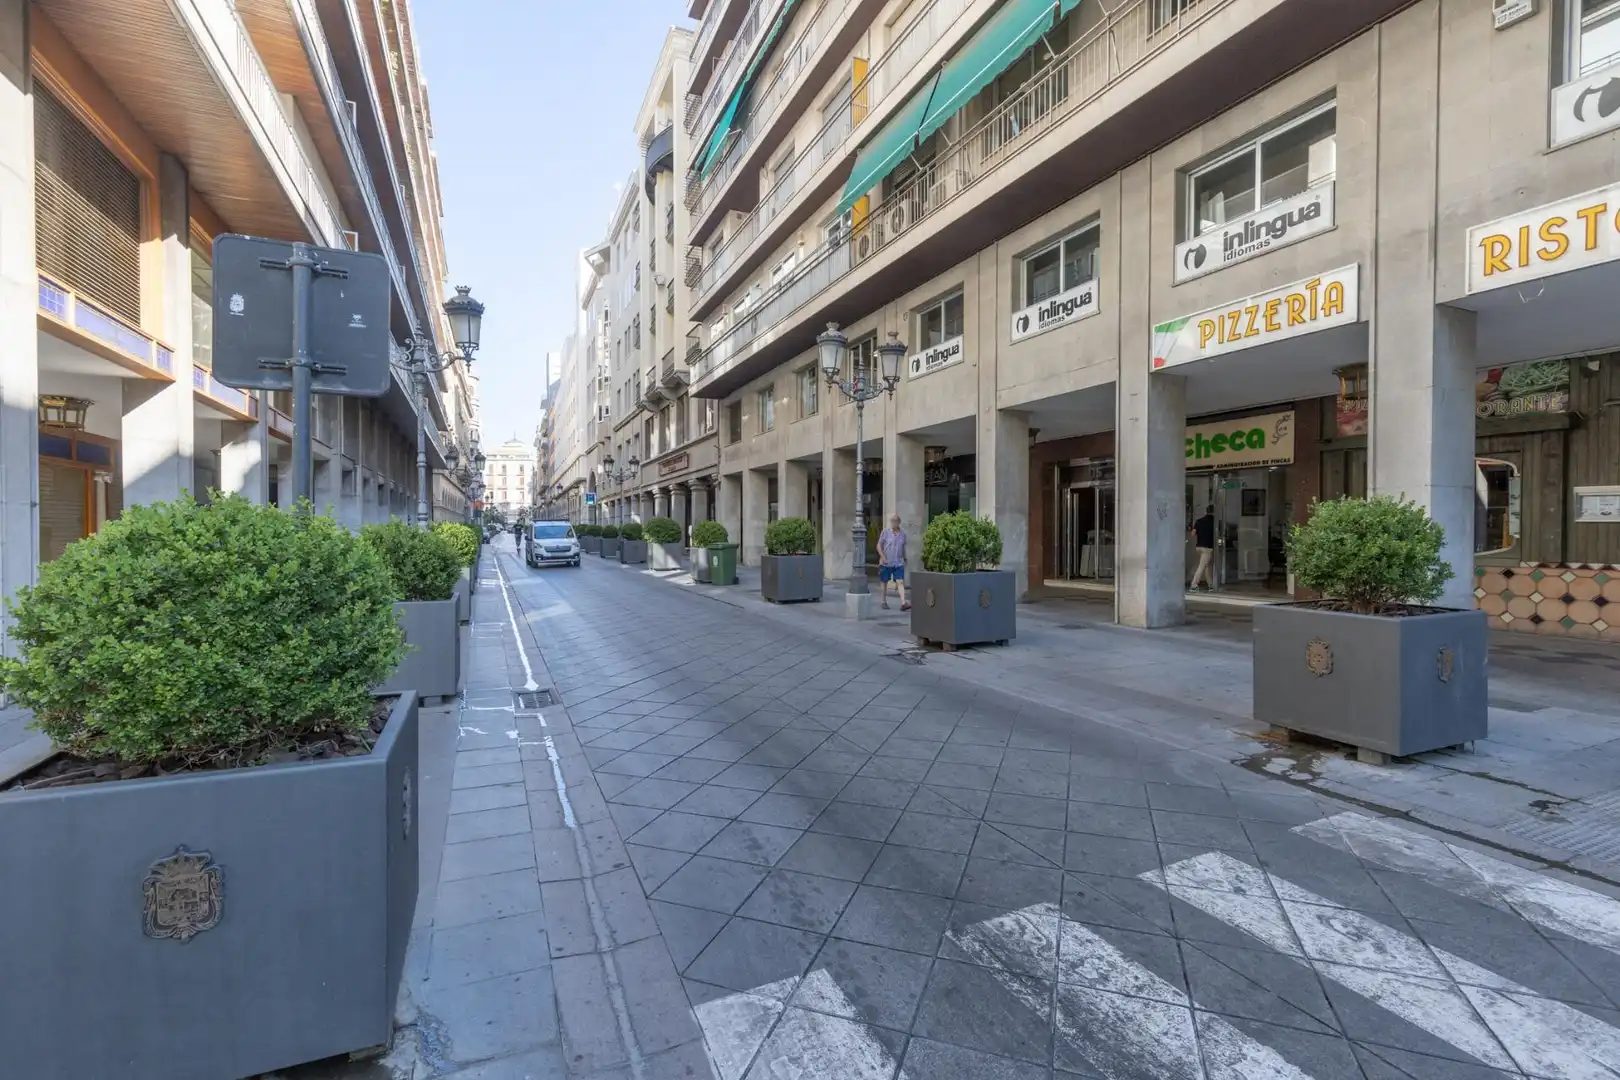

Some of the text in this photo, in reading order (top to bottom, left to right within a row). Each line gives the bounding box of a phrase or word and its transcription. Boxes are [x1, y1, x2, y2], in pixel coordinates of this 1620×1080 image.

[1223, 201, 1321, 252] inlingua
[1479, 202, 1620, 277] RIST
[1223, 238, 1271, 262] idiomas
[1038, 291, 1092, 322] inlingua
[1197, 278, 1344, 349] PIZZERÍA
[1038, 315, 1066, 330] idiomas
[925, 344, 960, 366] inlingua
